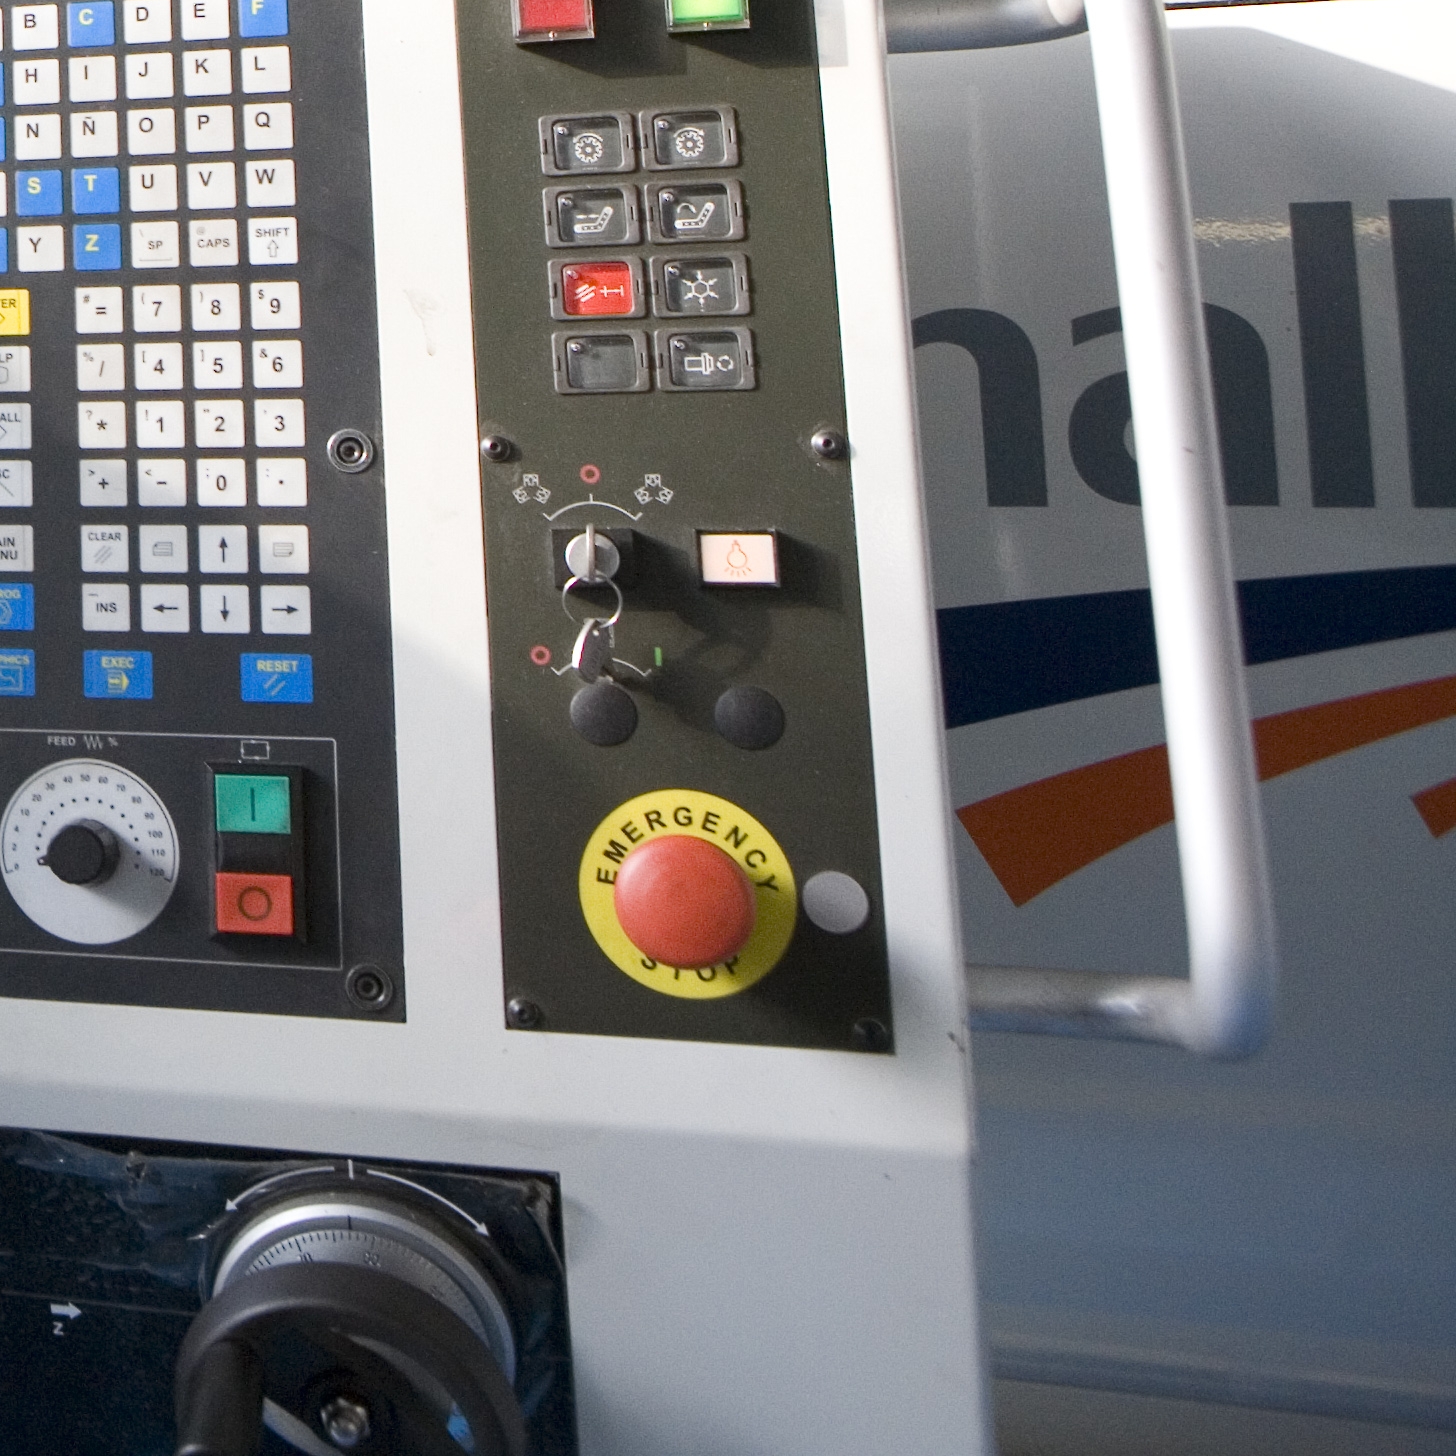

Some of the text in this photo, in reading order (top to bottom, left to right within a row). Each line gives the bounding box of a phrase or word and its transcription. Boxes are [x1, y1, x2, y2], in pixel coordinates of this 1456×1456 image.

[79, 9, 93, 25] C
[137, 7, 149, 22] D
[194, 4, 205, 18] E
[24, 14, 36, 28] B
[139, 63, 148, 77] J
[196, 59, 208, 74] K
[255, 56, 265, 71] L
[26, 68, 37, 83] H
[84, 65, 88, 80] I
[83, 117, 95, 135] Ñ
[140, 118, 154, 133] O
[198, 115, 209, 130] P
[256, 112, 270, 128] Q
[27, 124, 39, 138] N
[84, 175, 97, 191] T
[142, 174, 154, 189] U
[199, 172, 212, 186] V
[256, 168, 275, 184] W
[27, 177, 41, 194] S
[255, 227, 290, 238] SHIFT
[29, 238, 42, 252] Y
[85, 235, 99, 251] Z
[148, 240, 163, 250] SP
[197, 238, 230, 248] CAPS
[152, 302, 162, 316] 7
[211, 301, 221, 315] 8
[270, 299, 280, 314] 9
[153, 360, 164, 374] 4
[213, 359, 223, 373] 5
[273, 357, 283, 372] 6
[156, 418, 164, 432] 1
[215, 417, 225, 431] 2
[275, 416, 285, 430] 3
[216, 476, 227, 490] 0
[88, 532, 121, 541] CLEAR
[96, 603, 117, 613] INS
[102, 657, 133, 667] EXEC
[257, 661, 297, 671] RESET
[48, 736, 76, 745] FEED
[80, 774, 90, 782] 50
[98, 776, 108, 784] 60
[117, 784, 126, 792] 70
[597, 807, 779, 892] EMERGENCY
[53, 1322, 64, 1335] Z
